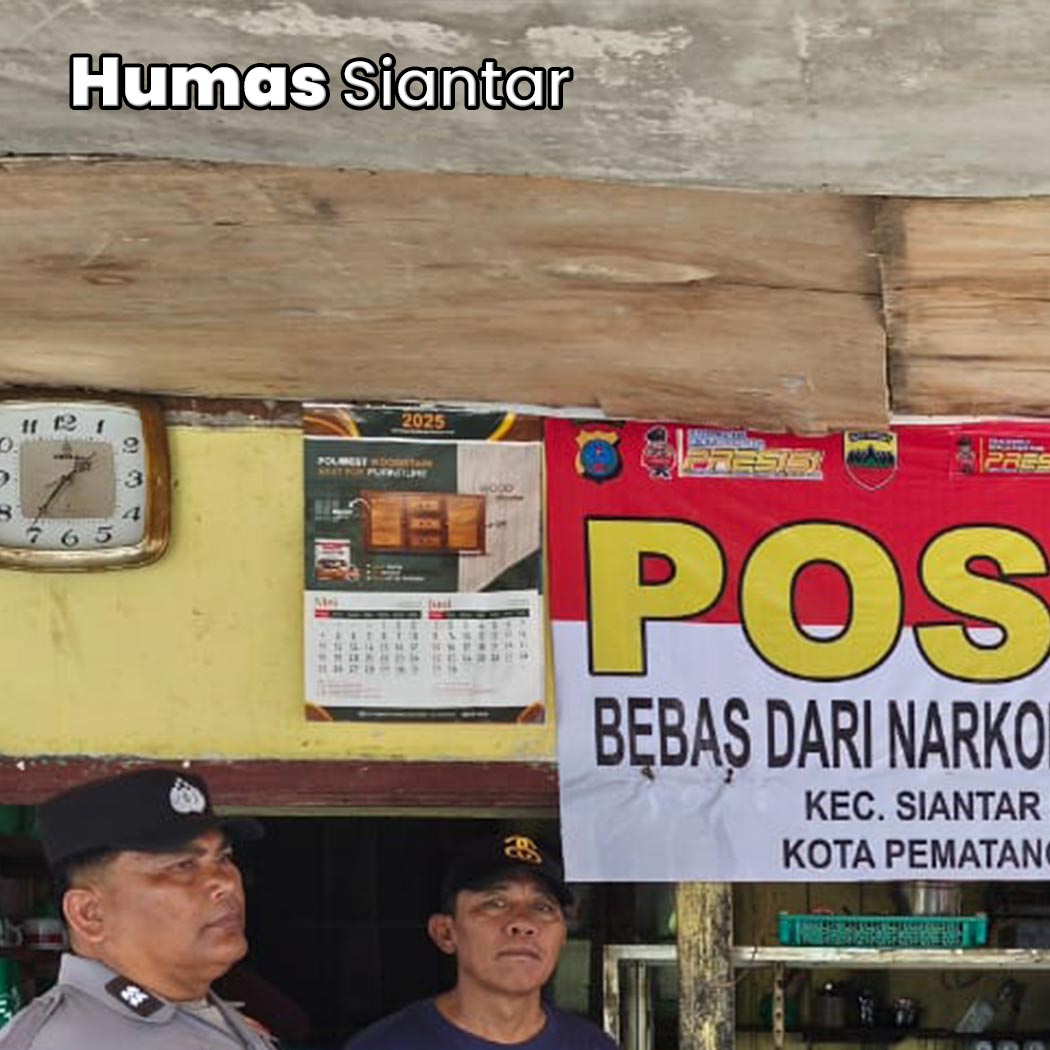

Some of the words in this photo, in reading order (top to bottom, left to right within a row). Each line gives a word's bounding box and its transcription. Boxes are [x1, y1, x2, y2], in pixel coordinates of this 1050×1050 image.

[22, 420, 38, 434] 11
[54, 414, 78, 431] 12
[96, 420, 106, 434] 1
[402, 413, 446, 428] 2025
[0, 437, 13, 453] 0
[123, 437, 140, 453] 2
[124, 470, 143, 488] 3
[122, 506, 141, 521] 4
[26, 527, 42, 543] 7
[61, 529, 79, 547] 6
[95, 526, 113, 543] 5
[594, 697, 751, 768] BEBAS
[768, 699, 872, 768] DARI
[806, 791, 884, 821] KEC.
[897, 791, 1041, 821] SIANTAR
[784, 839, 876, 869] KOTA
